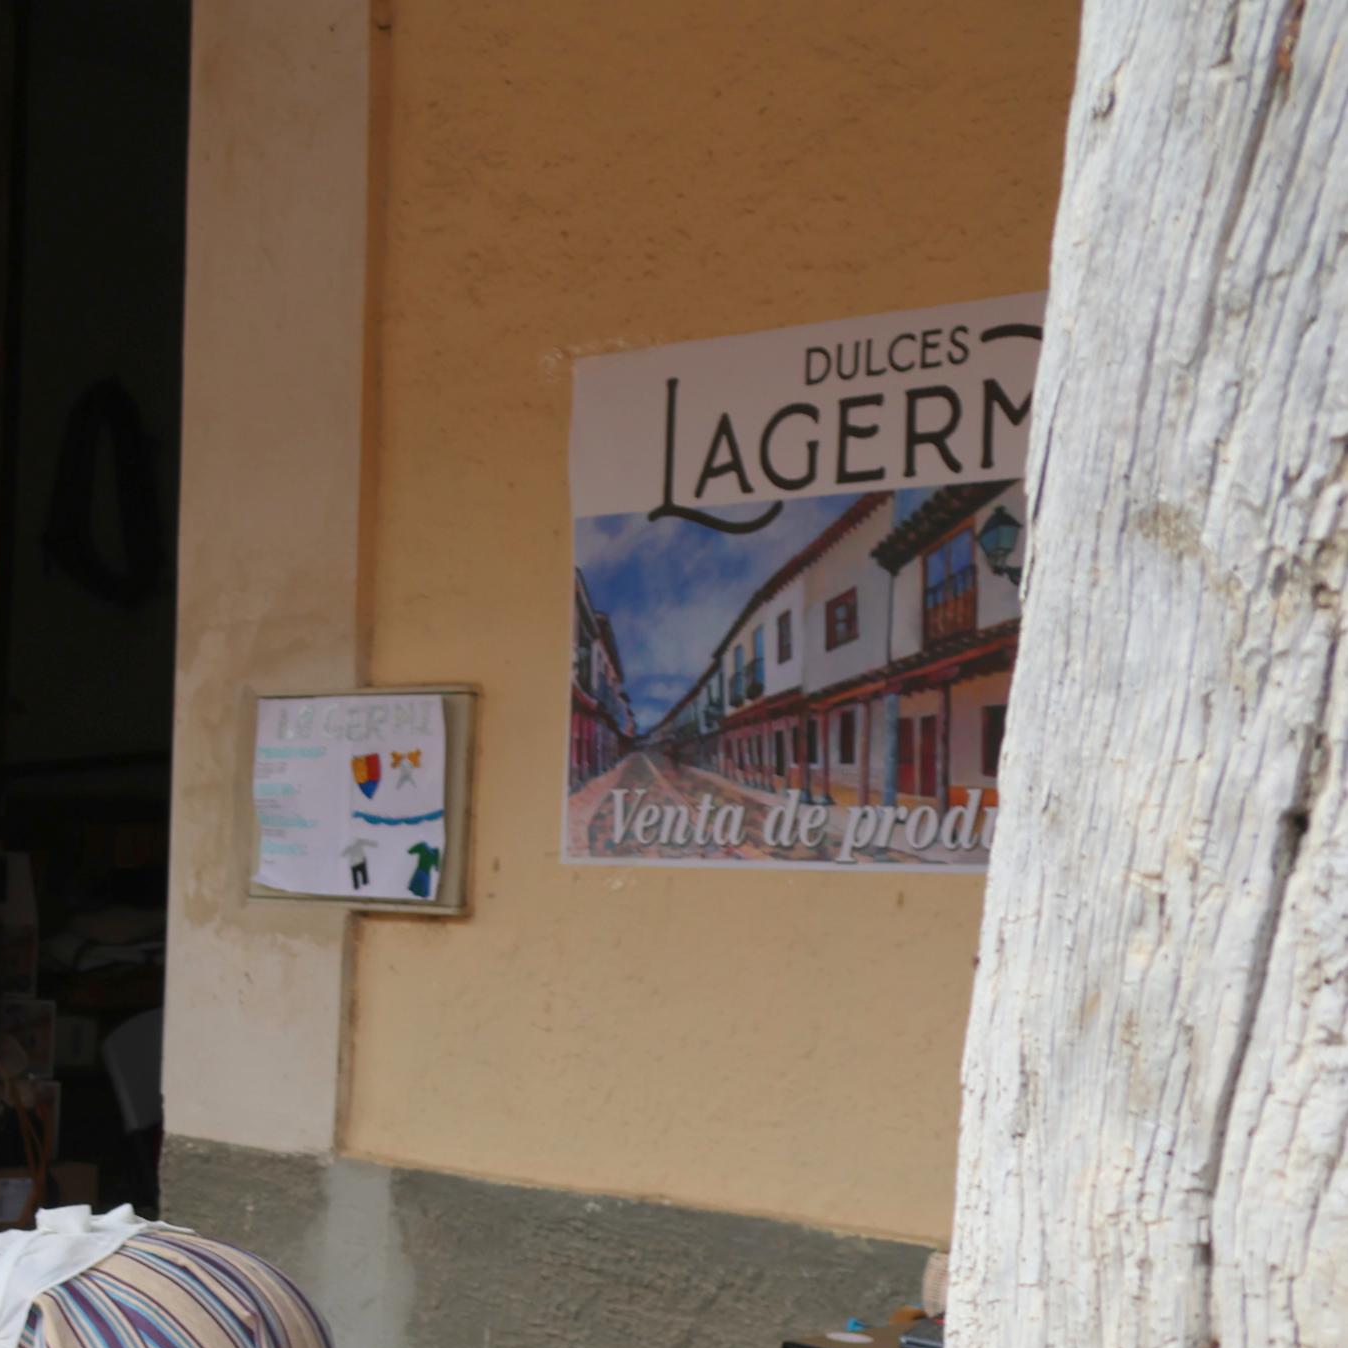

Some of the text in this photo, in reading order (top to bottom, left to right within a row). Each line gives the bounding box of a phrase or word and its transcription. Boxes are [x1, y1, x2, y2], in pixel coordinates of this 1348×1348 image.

[804, 325, 970, 386] DULCES
[648, 324, 1043, 534] LAGERM
[609, 788, 746, 847] Venta
[762, 788, 826, 849] de
